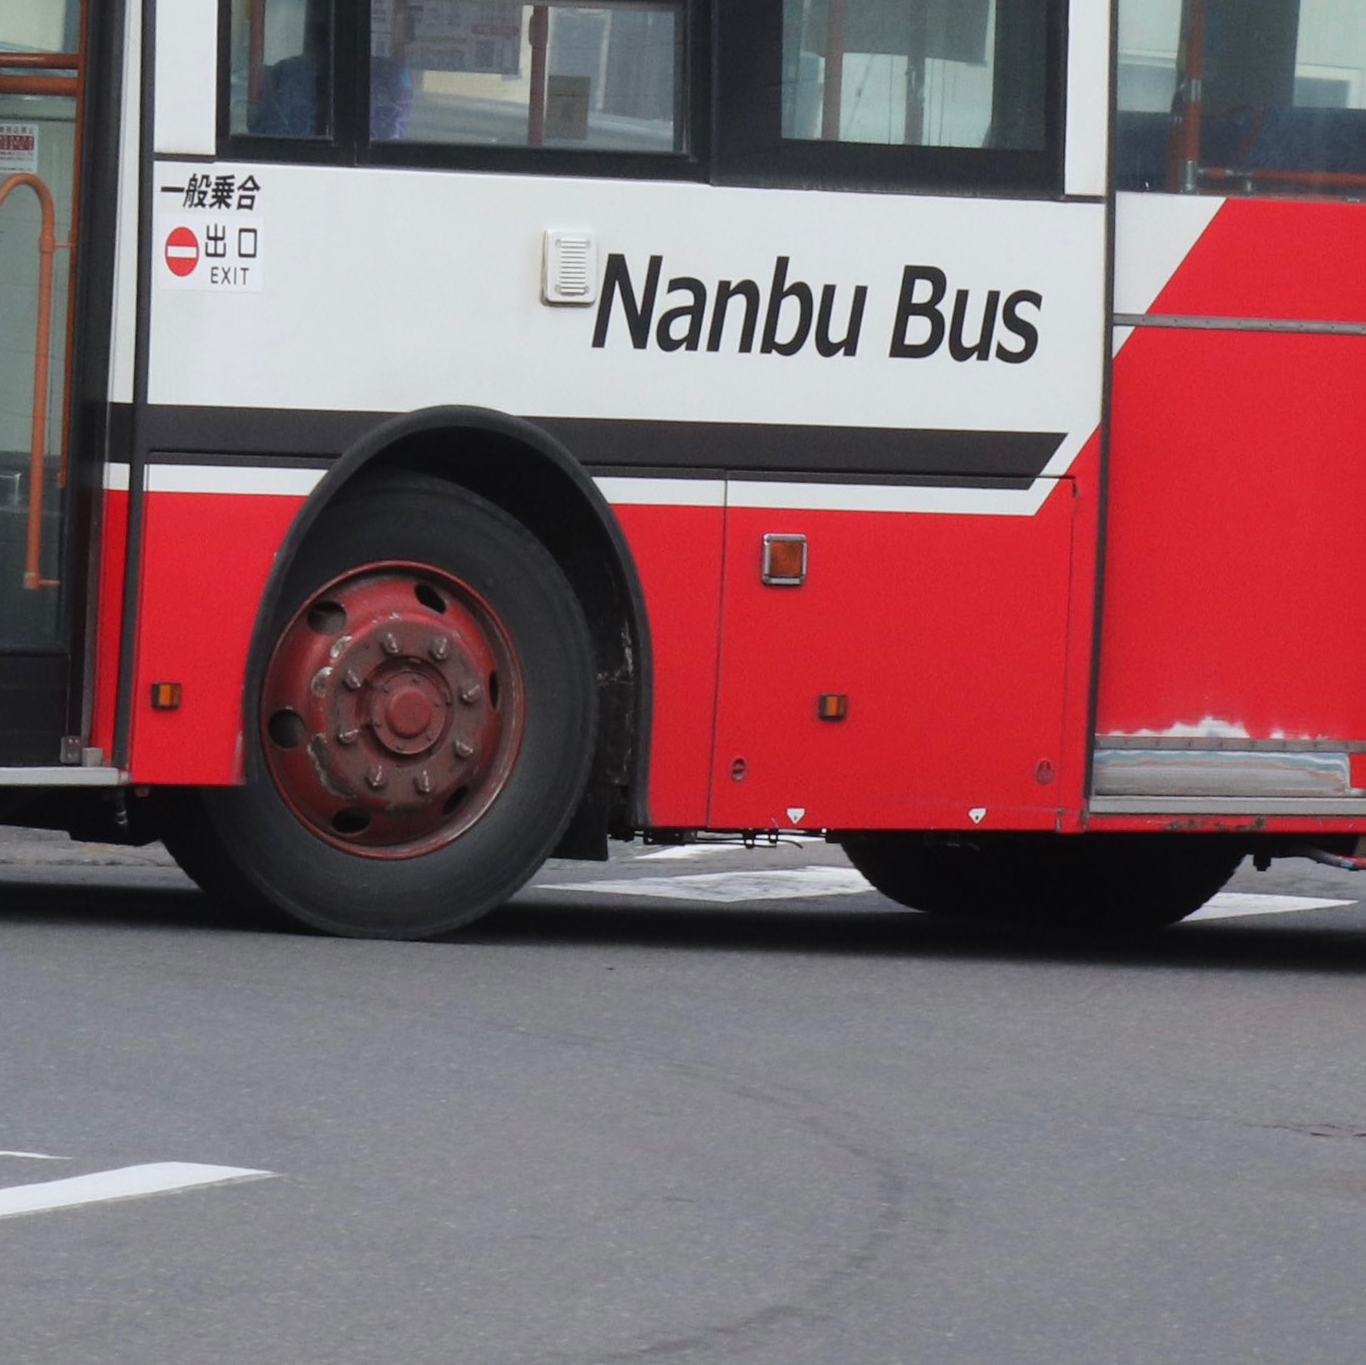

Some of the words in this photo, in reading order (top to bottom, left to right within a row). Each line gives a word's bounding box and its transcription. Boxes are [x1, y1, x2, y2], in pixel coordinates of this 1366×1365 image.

[160, 173, 261, 211] 一般乗合
[205, 223, 257, 258] 出口
[210, 266, 249, 285] EXIT
[591, 253, 868, 358] Nanbu
[888, 264, 1043, 364] Bus
